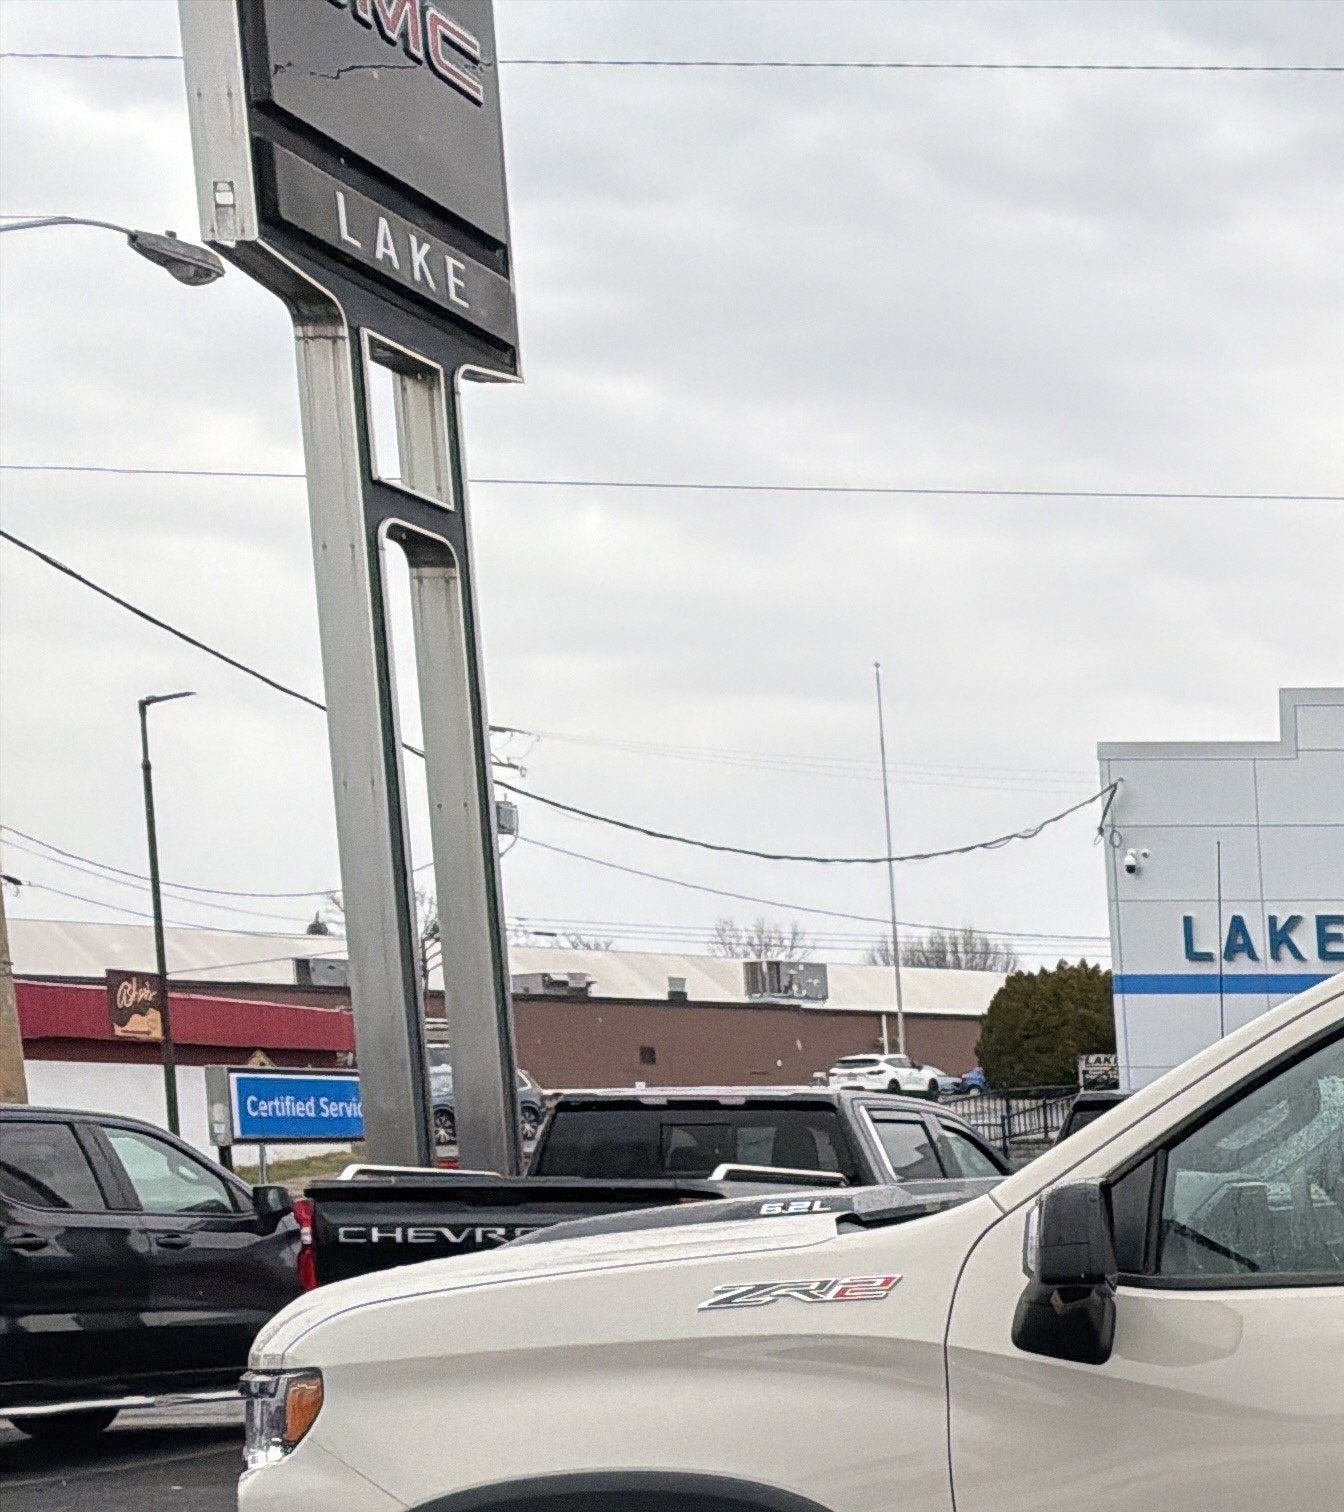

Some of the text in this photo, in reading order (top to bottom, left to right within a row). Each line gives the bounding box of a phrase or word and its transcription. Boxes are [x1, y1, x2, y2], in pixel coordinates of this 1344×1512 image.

[327, 0, 484, 107] MC
[335, 190, 470, 309] LAKE
[246, 1095, 316, 1117] Certified
[760, 1200, 831, 1215] 6.2L
[698, 1273, 903, 1312] ZR2
